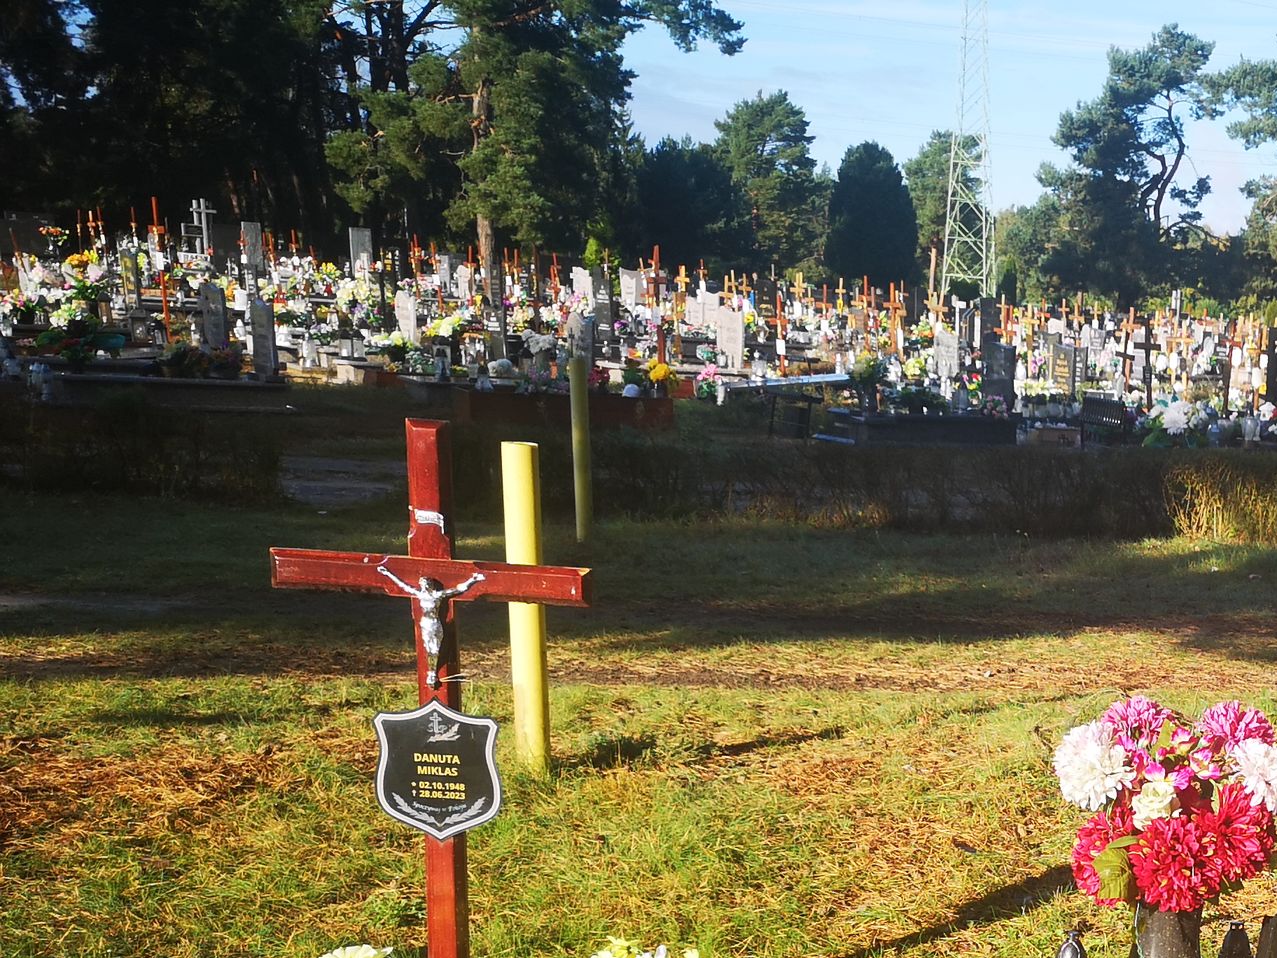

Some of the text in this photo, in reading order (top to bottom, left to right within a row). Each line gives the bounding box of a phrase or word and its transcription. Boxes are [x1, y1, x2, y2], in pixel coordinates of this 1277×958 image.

[413, 752, 461, 765] DANUTA
[417, 765, 459, 777] MIKLAS
[418, 780, 466, 791] 02.10.1948
